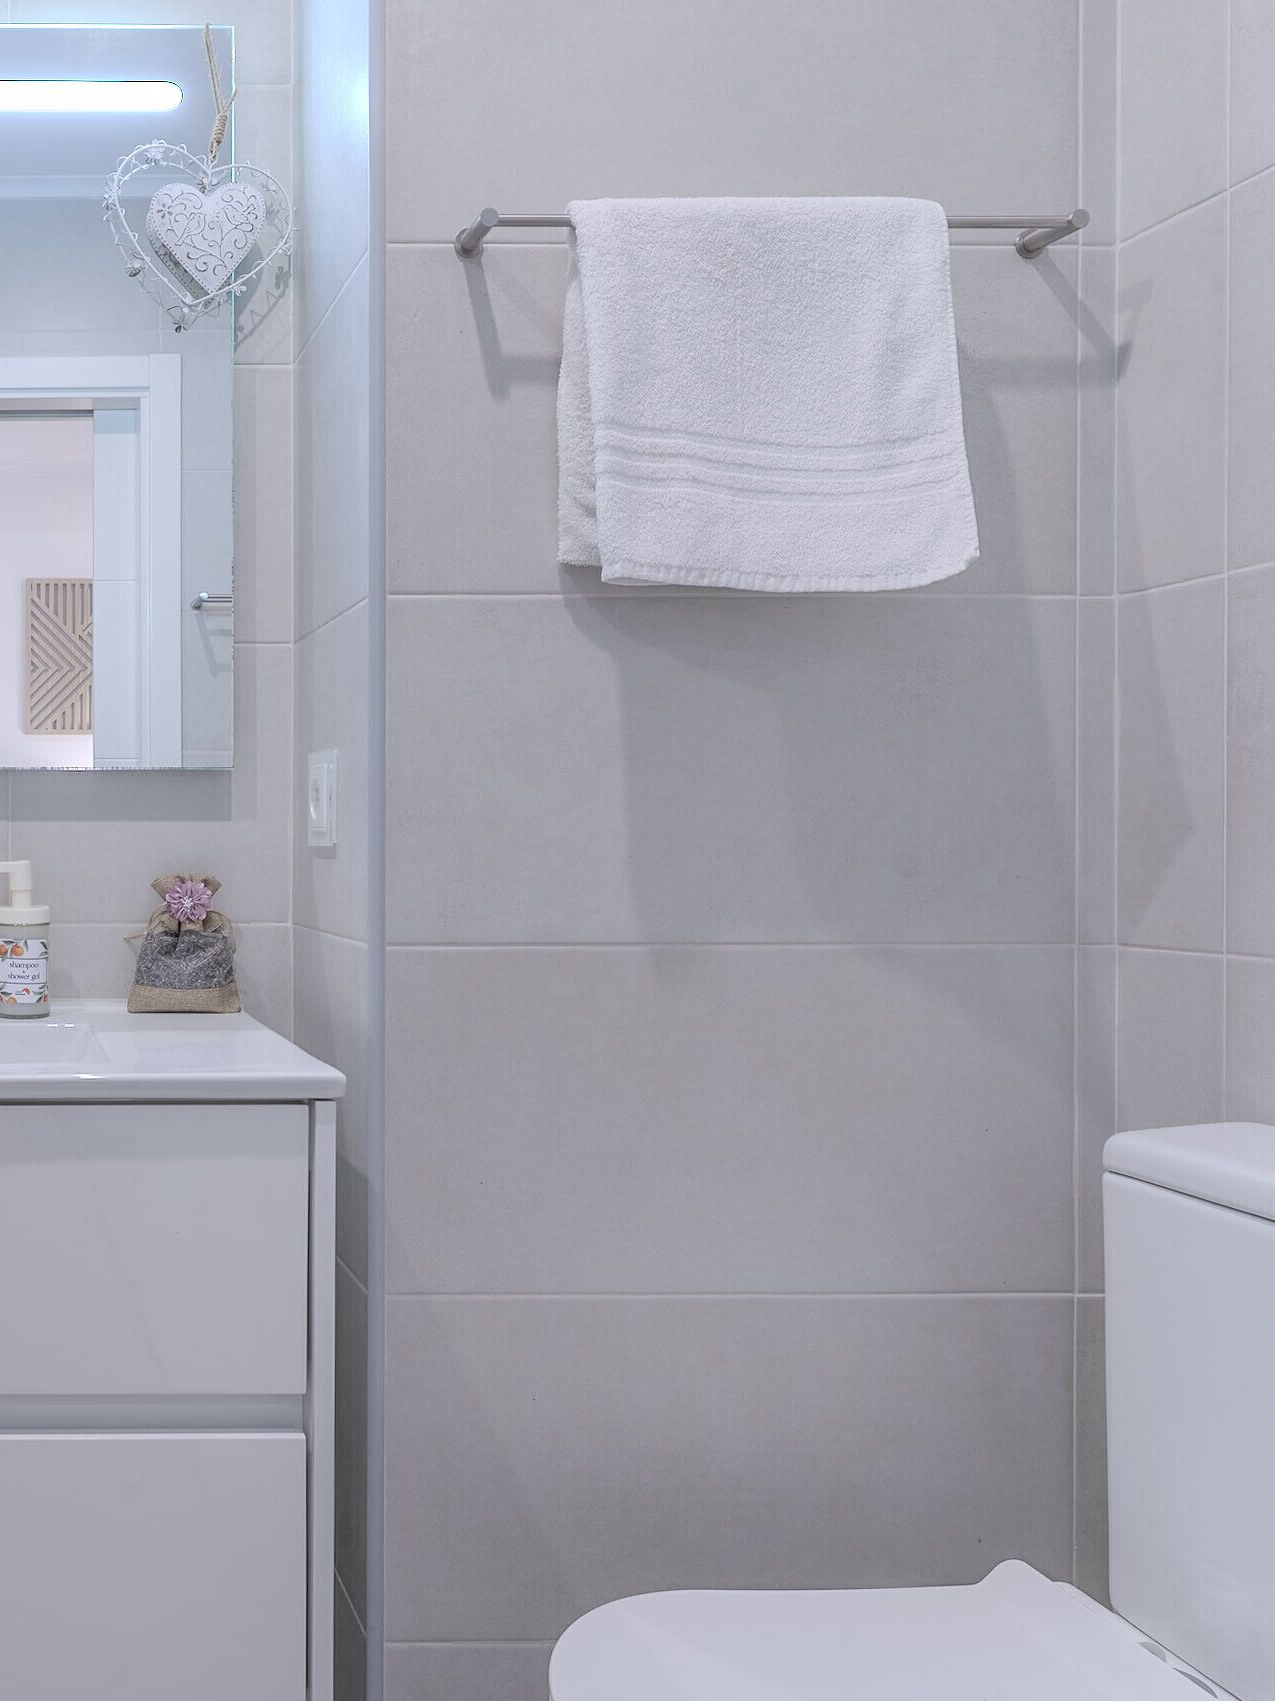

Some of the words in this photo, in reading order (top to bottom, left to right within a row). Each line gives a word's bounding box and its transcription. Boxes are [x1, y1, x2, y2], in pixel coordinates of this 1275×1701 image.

[9, 961, 39, 969] shampoo
[8, 972, 30, 980] shower
[31, 972, 40, 982] gel
